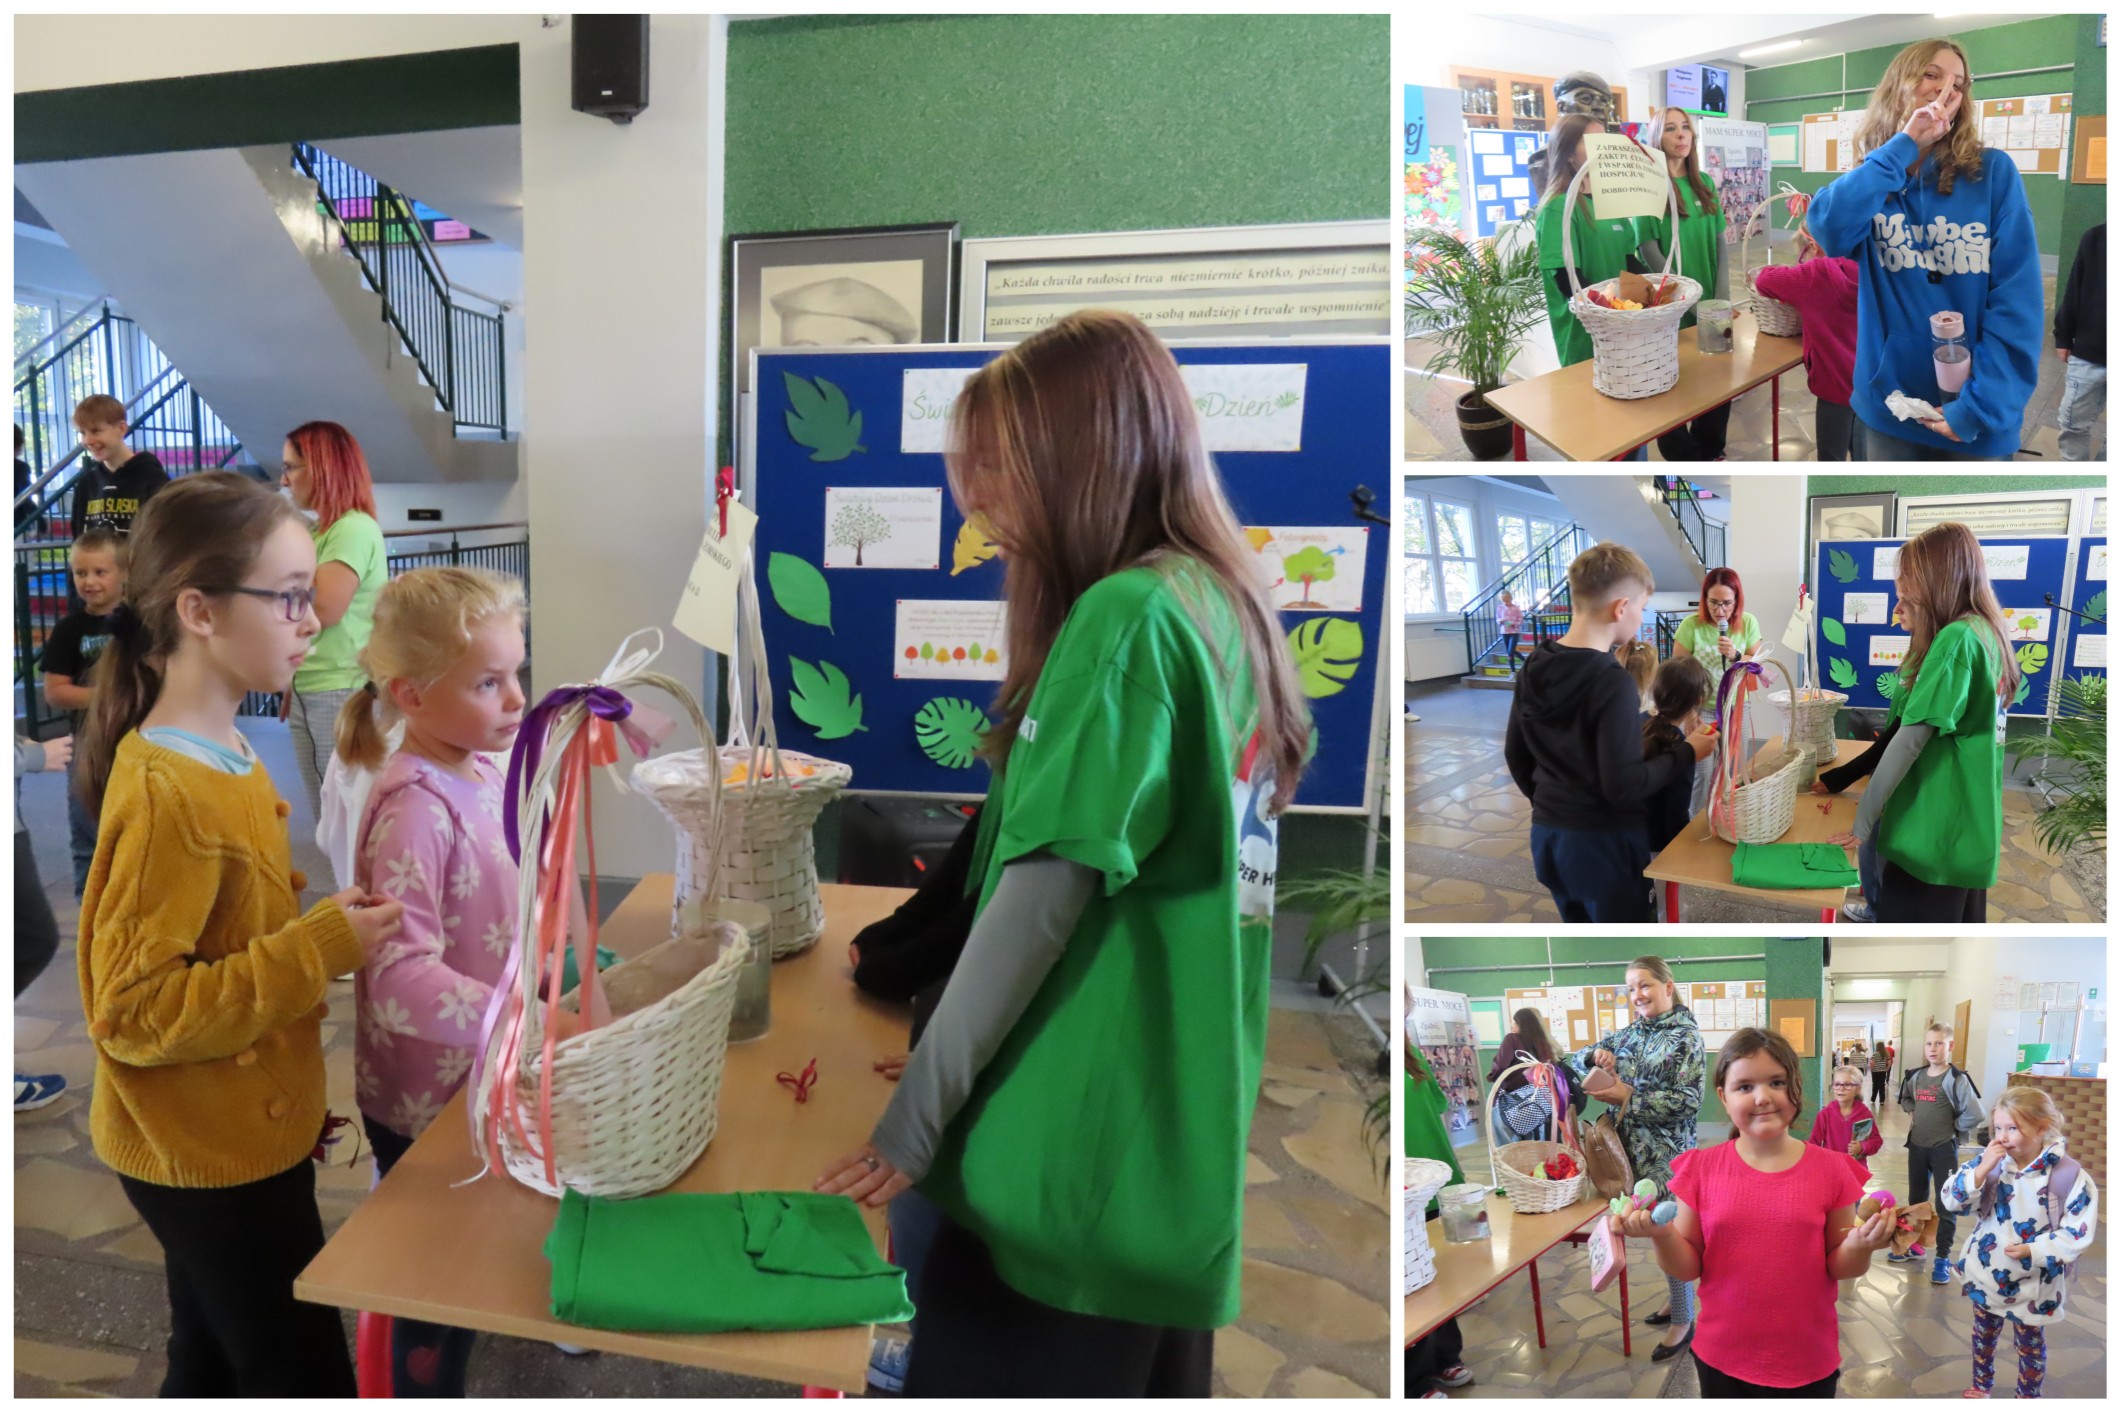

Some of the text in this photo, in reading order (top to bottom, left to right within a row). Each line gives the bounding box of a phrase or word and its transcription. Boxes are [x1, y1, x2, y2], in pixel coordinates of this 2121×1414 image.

[1042, 274, 1083, 287] chwila
[1086, 272, 1132, 285] radości
[1134, 272, 1163, 284] trwa
[1170, 270, 1243, 283] niezmiernie
[1247, 266, 1294, 279] krótko,
[990, 316, 1033, 327] zawsze
[1138, 310, 1153, 321] za
[1156, 308, 1185, 322] sobą
[1188, 305, 1242, 321] nadzieję
[1205, 391, 1275, 418] Dzień
[1239, 859, 1260, 884] PER
